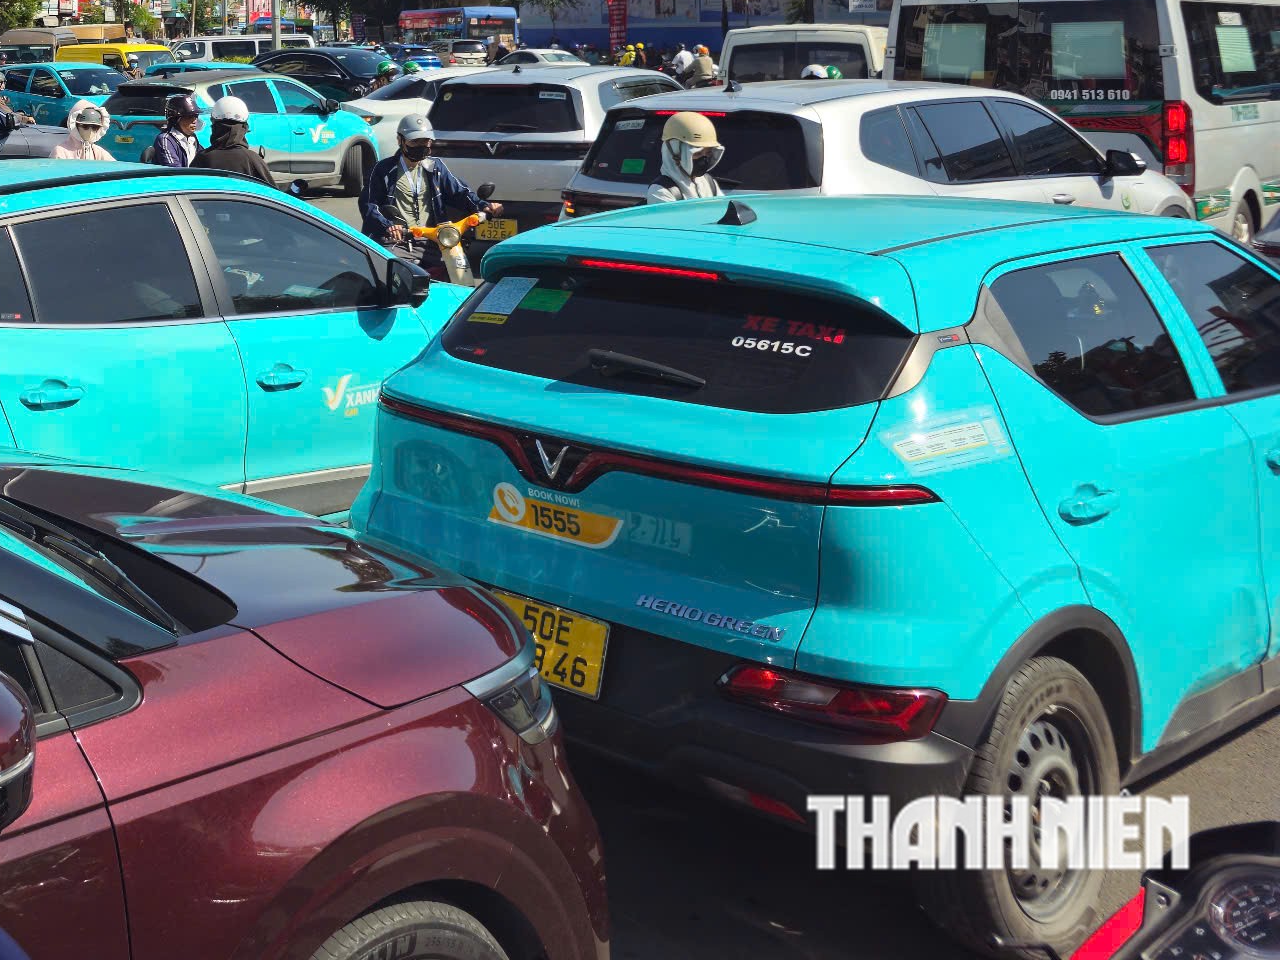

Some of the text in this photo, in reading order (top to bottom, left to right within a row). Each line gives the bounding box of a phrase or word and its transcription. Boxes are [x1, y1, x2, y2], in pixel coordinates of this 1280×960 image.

[1050, 89, 1130, 100] 0941 513 610
[742, 314, 847, 344] XE TAXI
[731, 336, 812, 358] 05615C
[528, 487, 581, 508] BOOK NOW!
[531, 503, 581, 537] 1555
[523, 604, 574, 647] 50E
[636, 593, 787, 643] HERIO GREEN
